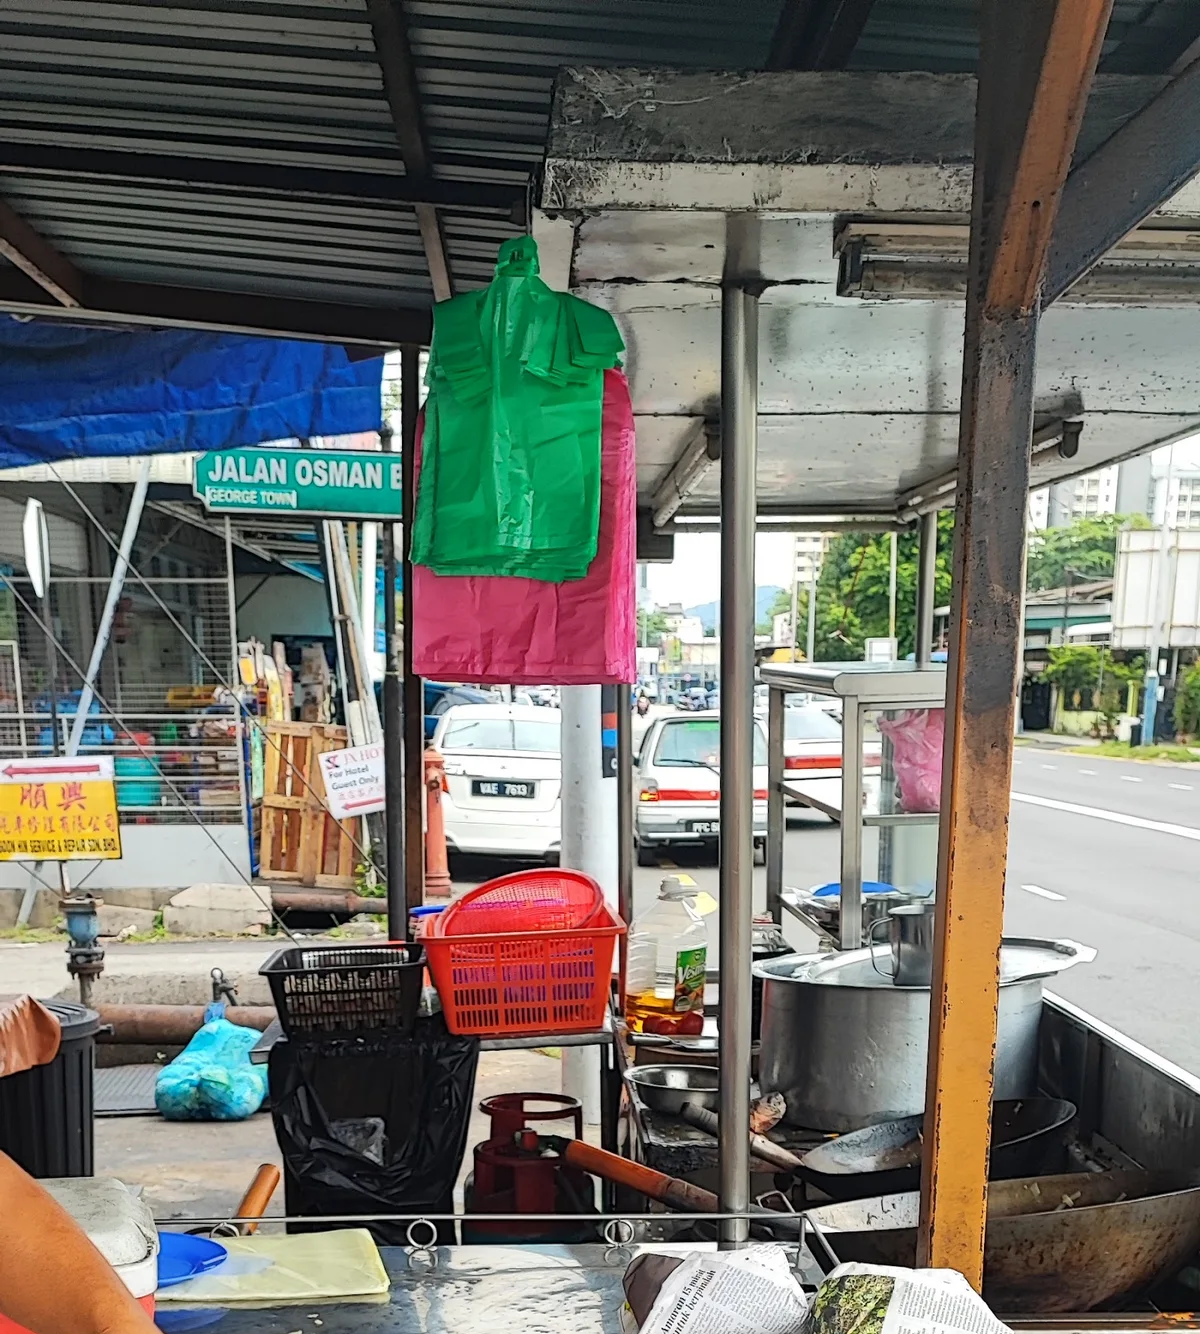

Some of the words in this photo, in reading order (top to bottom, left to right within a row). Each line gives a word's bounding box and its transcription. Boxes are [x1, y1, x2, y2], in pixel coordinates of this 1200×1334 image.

[208, 455, 287, 485] JALAN
[294, 459, 382, 489] OSMAN
[209, 488, 257, 504] GEORGE
[260, 491, 294, 506] TOWN
[328, 770, 343, 778] For
[345, 764, 369, 776] Hotel
[332, 779, 357, 790] Guest
[358, 775, 379, 785] Only
[30, 838, 56, 853] SERVICE
[64, 838, 85, 852] REPAIR
[687, 1269, 716, 1312] berpindah
